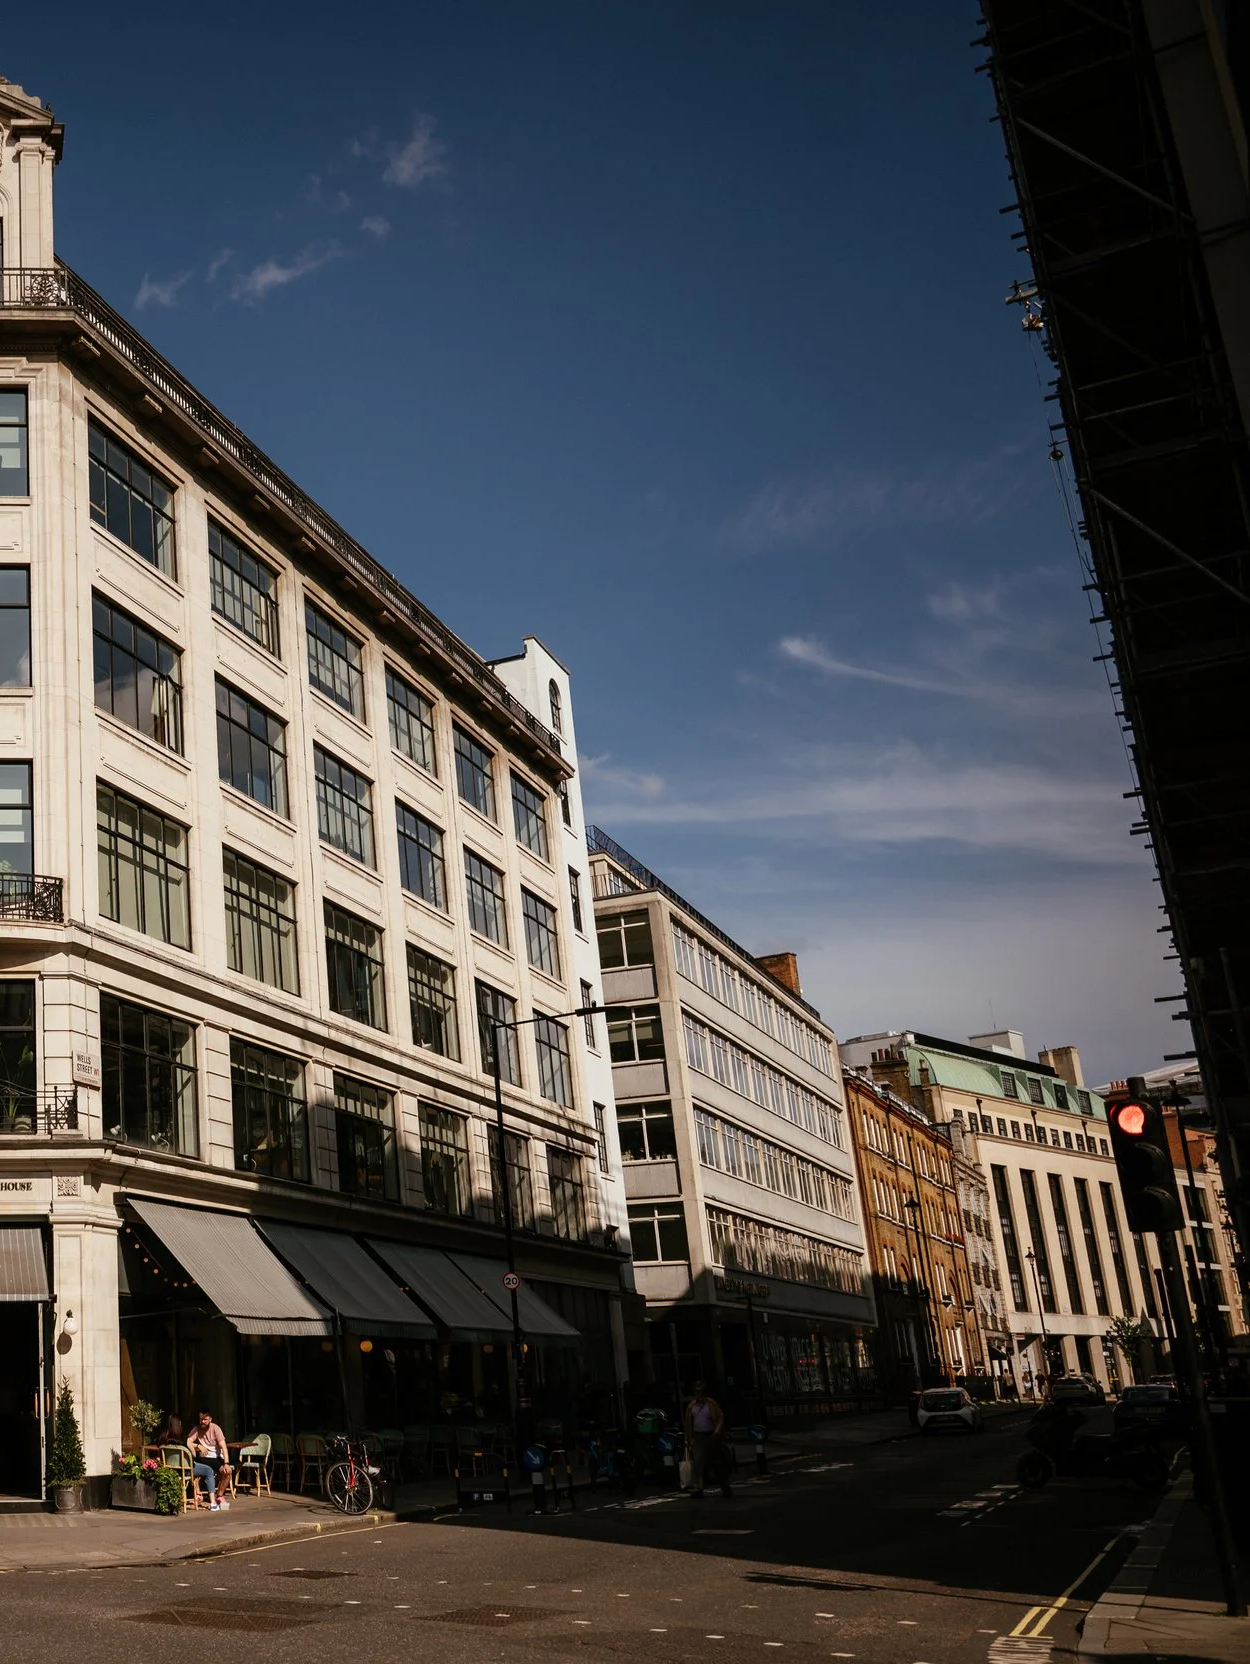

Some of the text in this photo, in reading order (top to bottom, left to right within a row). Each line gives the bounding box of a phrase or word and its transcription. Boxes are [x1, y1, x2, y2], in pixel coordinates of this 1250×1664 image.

[77, 1054, 91, 1065] WELLS
[77, 1063, 100, 1077] STREET W1
[0, 1182, 32, 1191] HOUSE
[505, 1277, 518, 1285] 20
